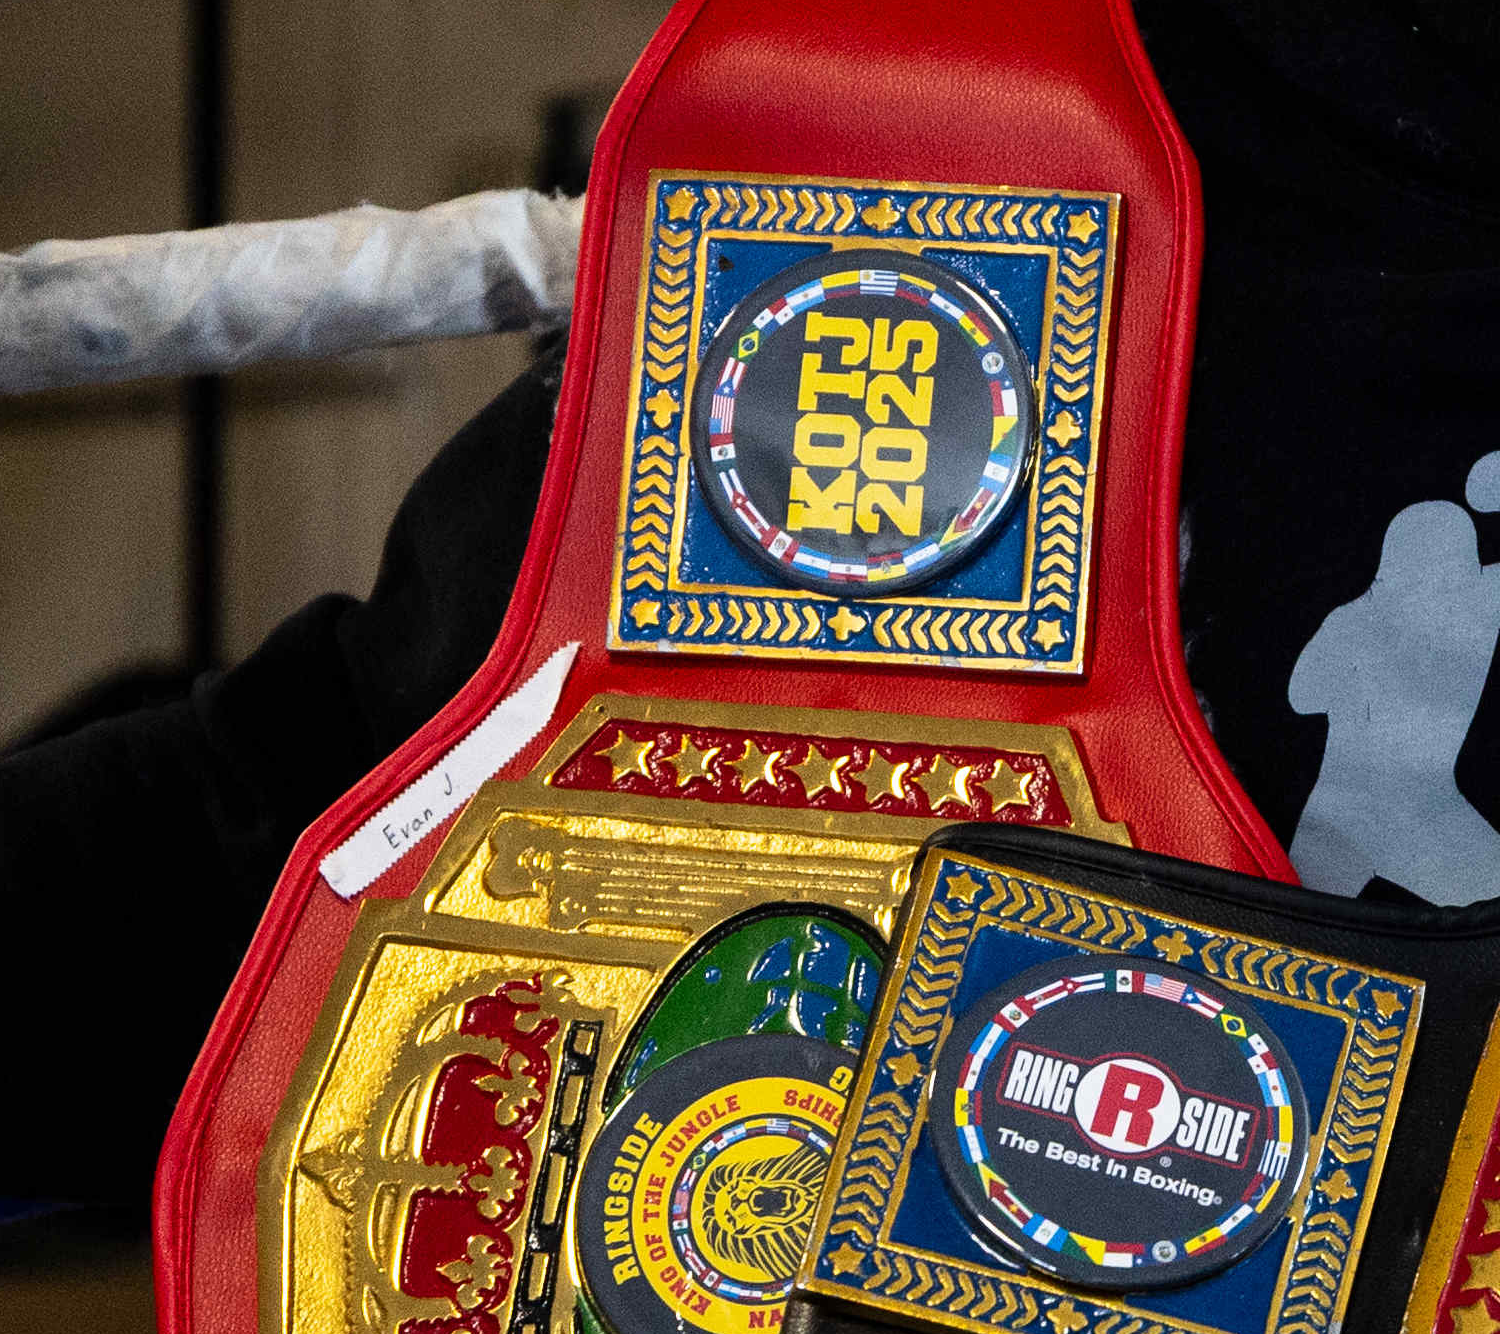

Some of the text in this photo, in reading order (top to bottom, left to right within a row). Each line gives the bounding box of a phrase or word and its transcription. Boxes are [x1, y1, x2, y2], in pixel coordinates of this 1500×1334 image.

[786, 311, 870, 536] KOTJ
[856, 317, 939, 537] 2025
[382, 807, 434, 850] Evan
[997, 1126, 1040, 1156] The
[1044, 1139, 1102, 1174] Best
[1105, 1155, 1129, 1179] In
[1004, 1049, 1251, 1163] RING R SIDE
[604, 1112, 664, 1286] RINGSIDE
[642, 1094, 742, 1317] KING OF THE JUNGLE
